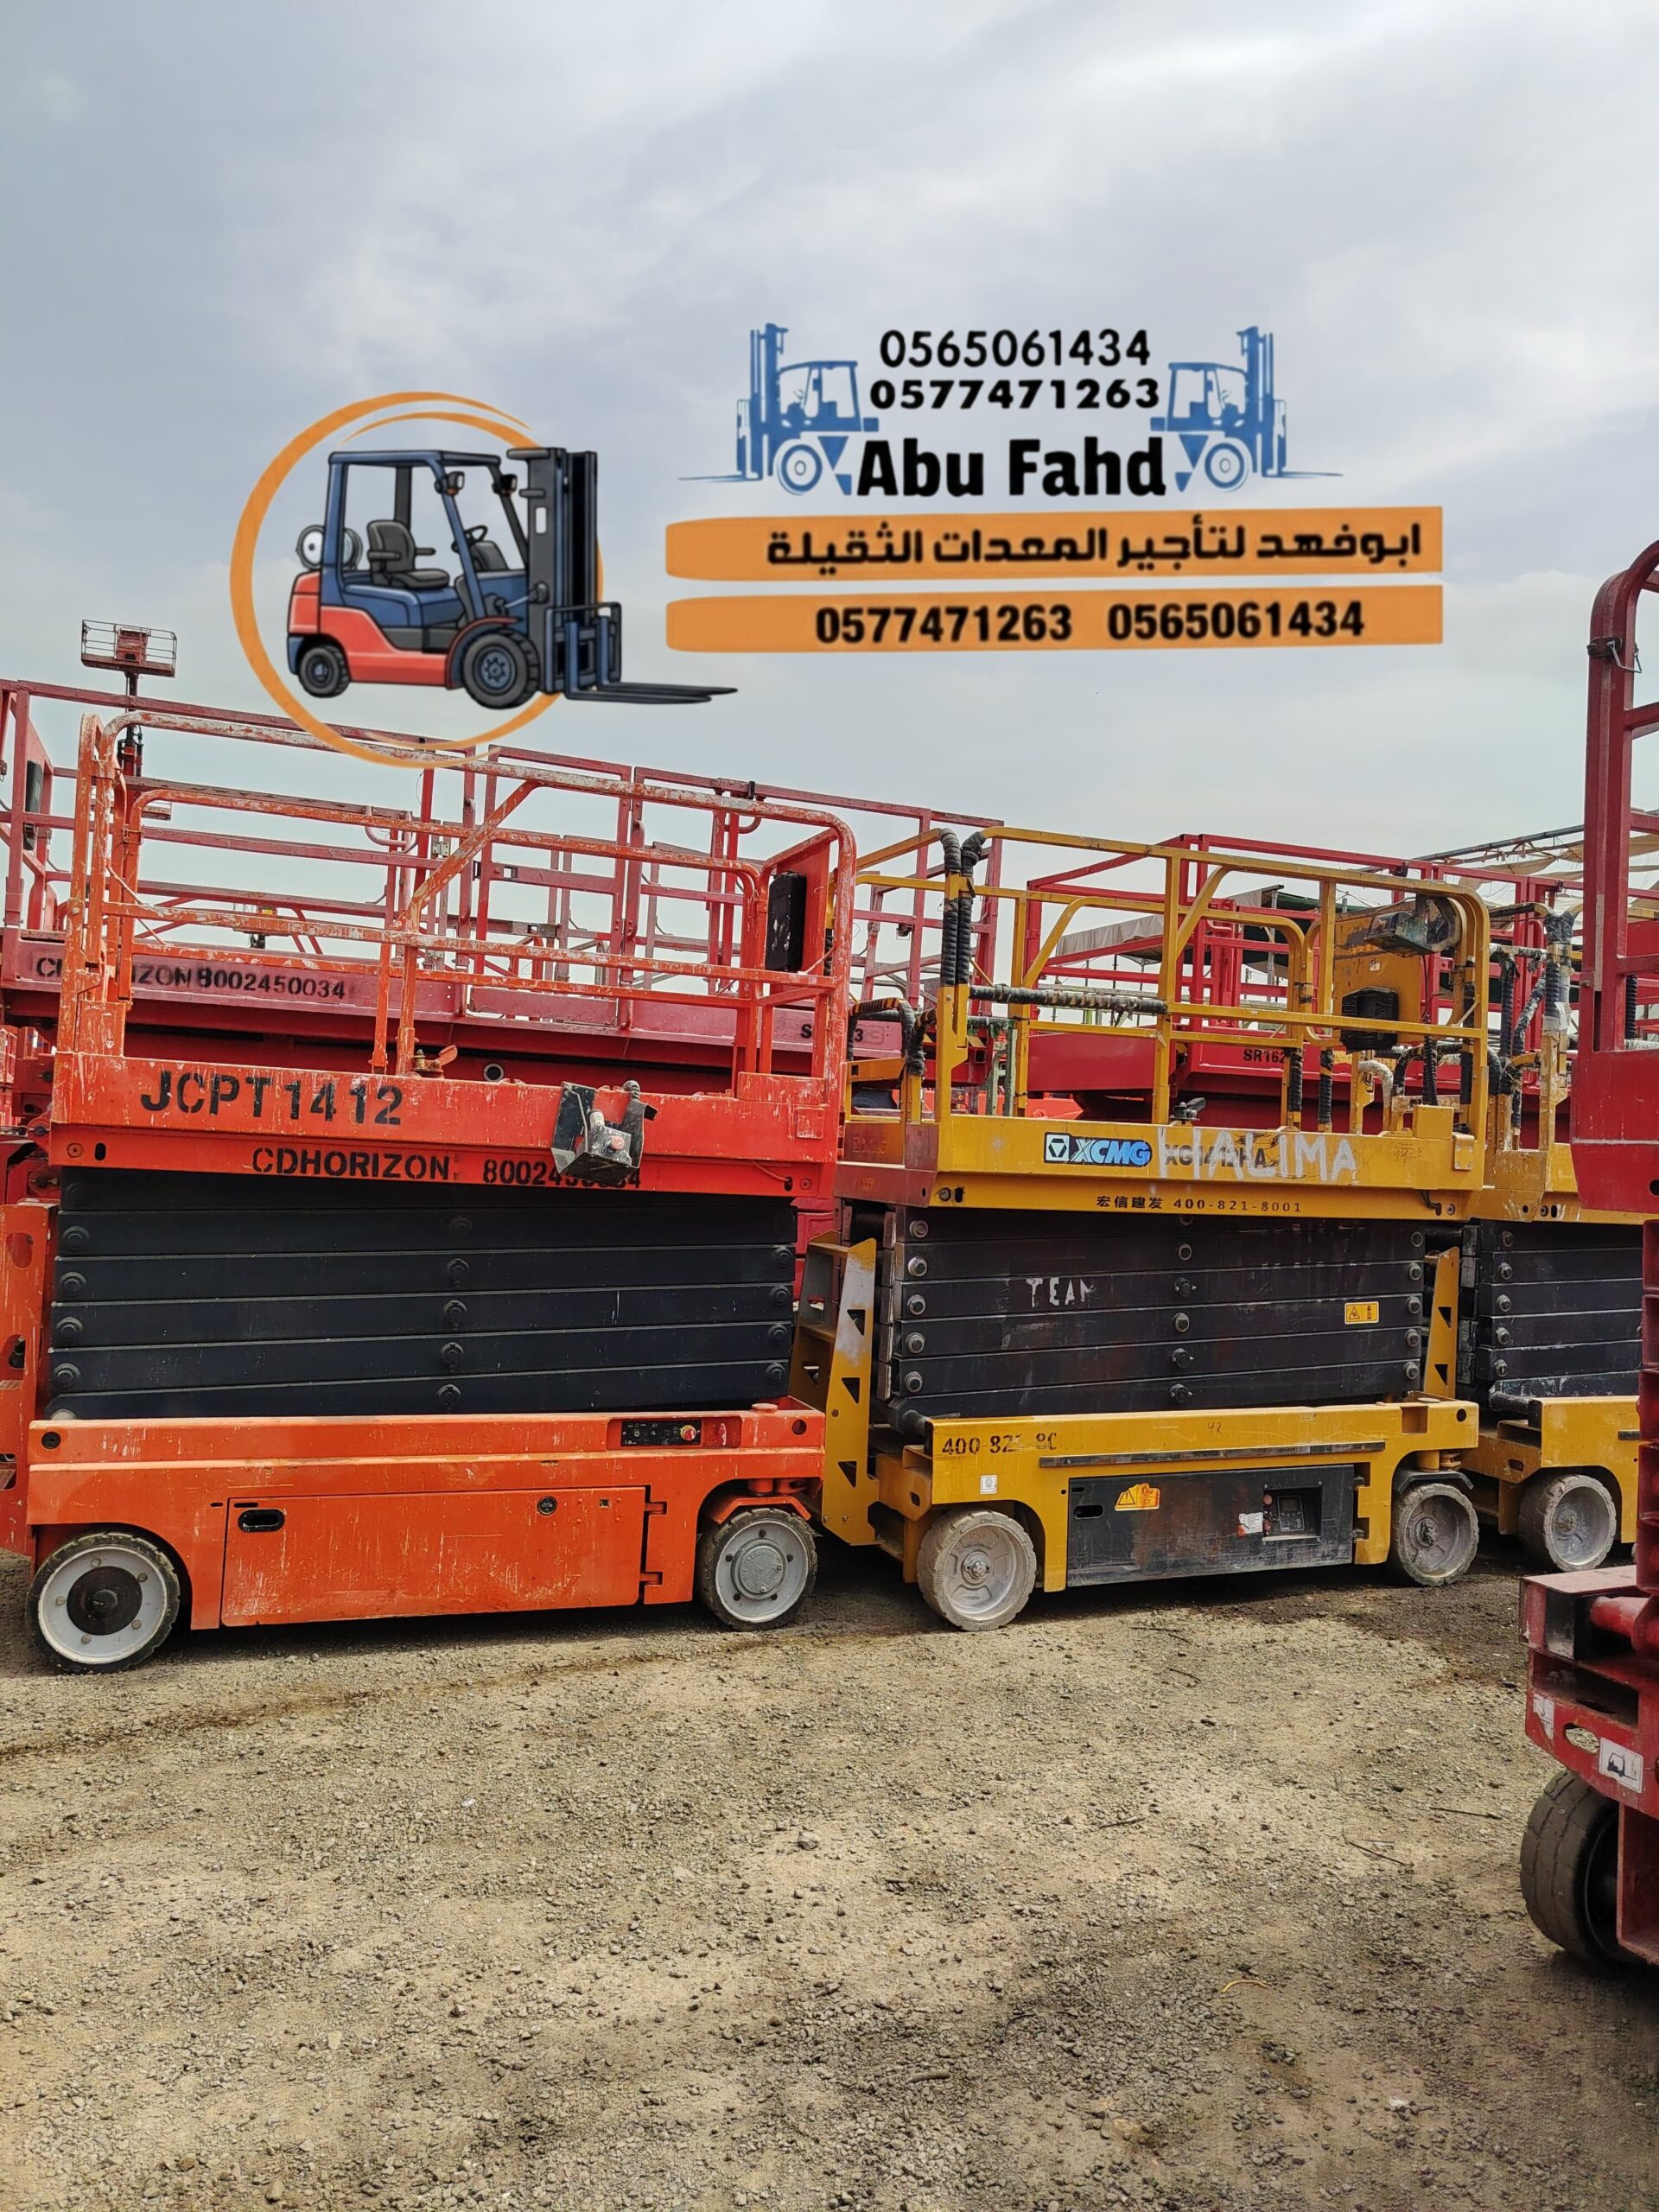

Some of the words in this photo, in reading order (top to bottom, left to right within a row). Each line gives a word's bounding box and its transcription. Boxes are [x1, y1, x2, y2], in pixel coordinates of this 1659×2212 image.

[197, 969, 346, 1000] 8002450034
[252, 1147, 450, 1181] CDHORIZON
[1070, 1138, 1151, 1166] XCMG
[1158, 1126, 1358, 1184] HALIMA
[1096, 1195, 1164, 1210] 宏信建发
[1173, 1198, 1300, 1212] 400-821-8001
